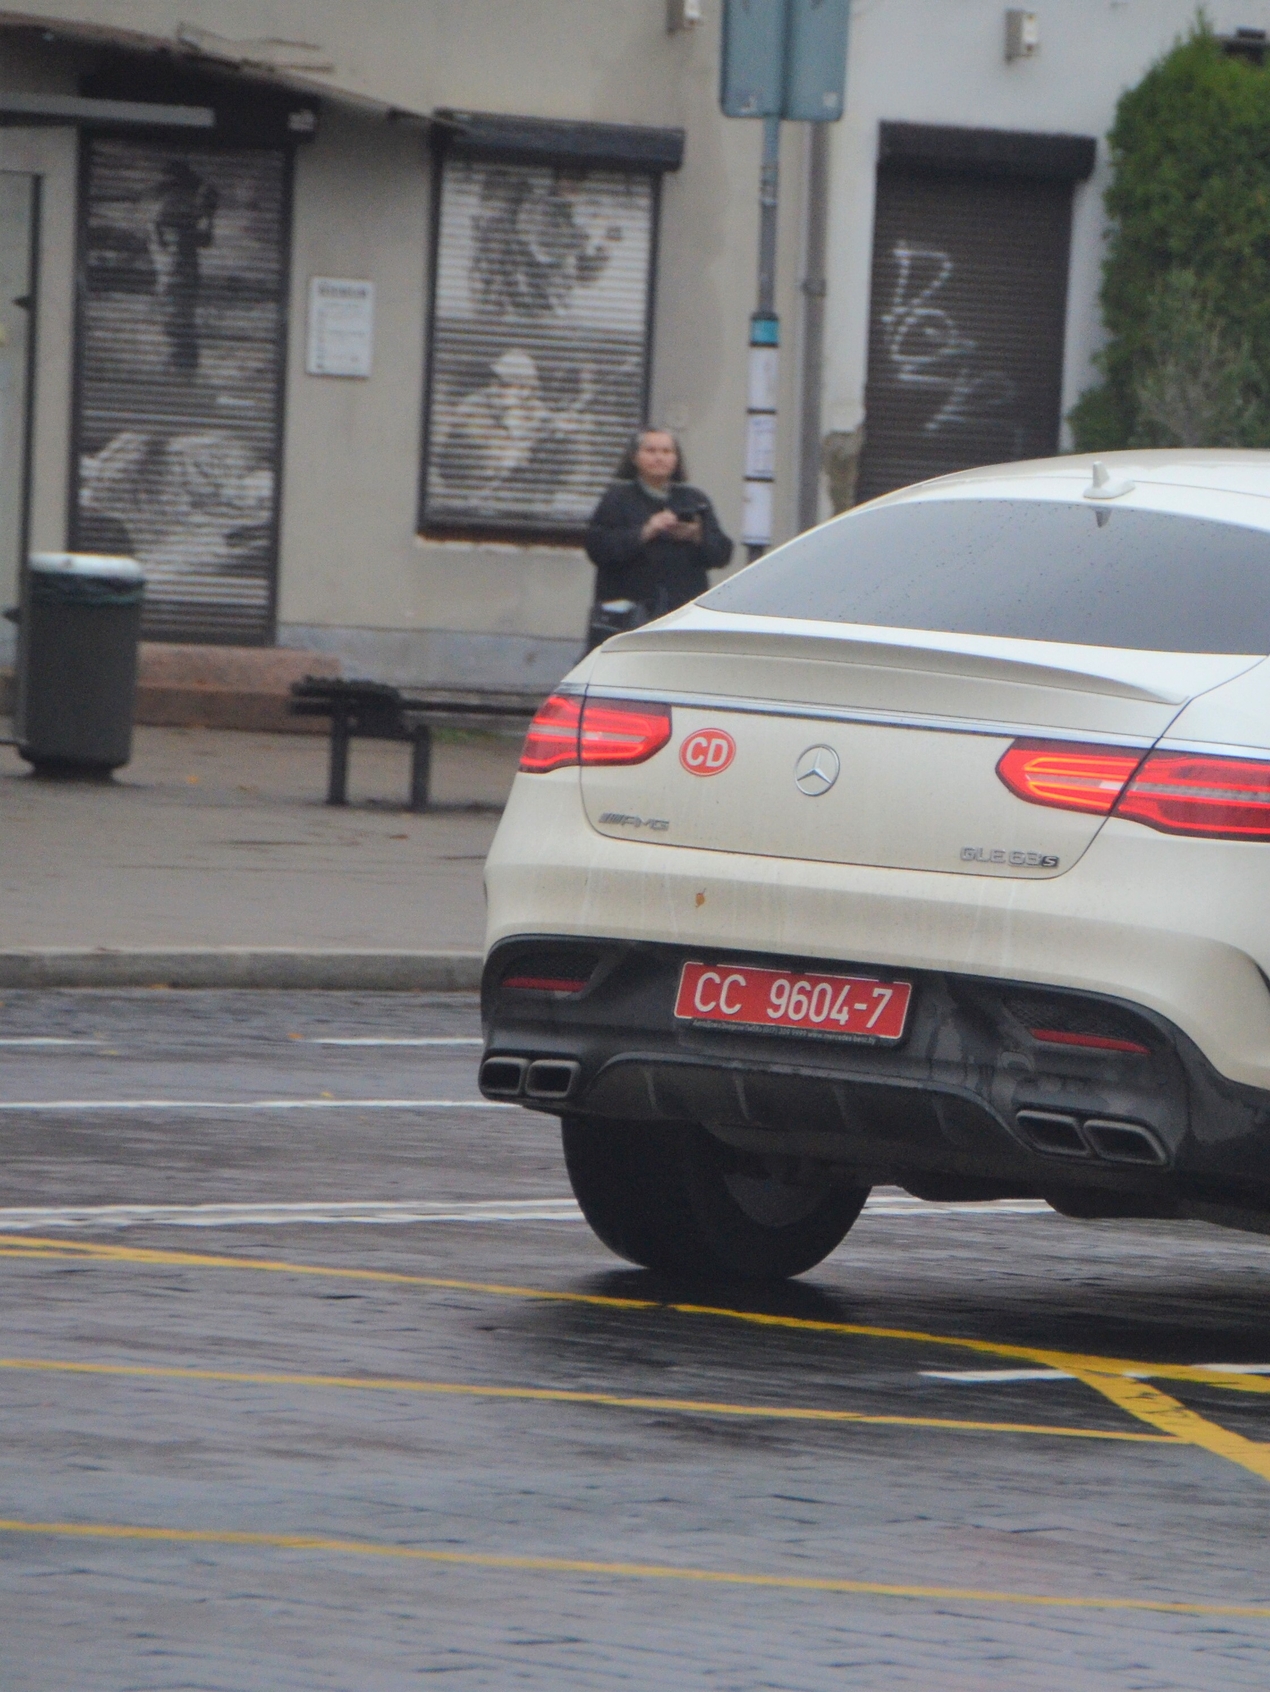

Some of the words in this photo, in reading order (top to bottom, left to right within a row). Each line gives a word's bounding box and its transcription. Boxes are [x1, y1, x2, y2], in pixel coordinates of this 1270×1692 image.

[686, 737, 730, 767] CD
[694, 971, 747, 1014] CC
[767, 978, 893, 1029] 9604-7
